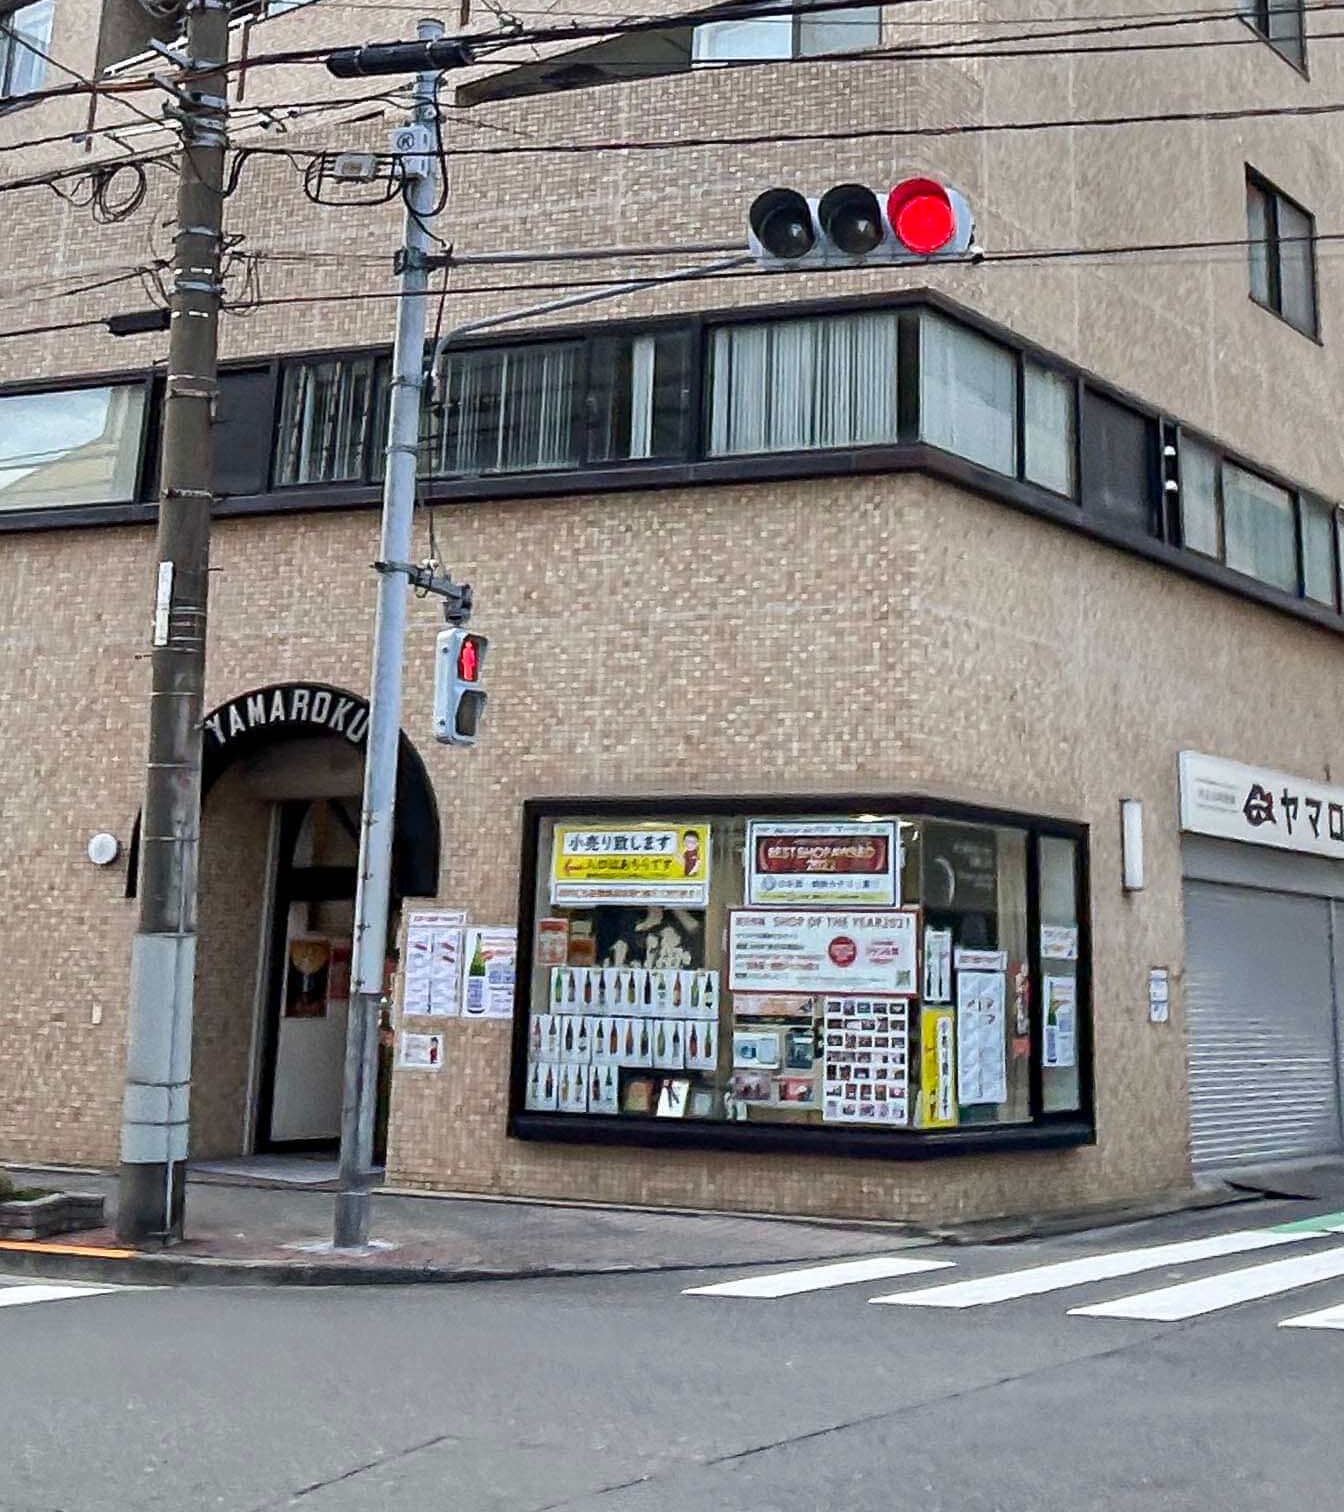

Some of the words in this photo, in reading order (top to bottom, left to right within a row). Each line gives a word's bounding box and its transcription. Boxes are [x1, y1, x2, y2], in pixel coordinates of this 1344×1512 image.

[205, 688, 369, 745] YAMAROKU
[568, 835, 672, 851] 小売り致します
[807, 916, 822, 928] OF
